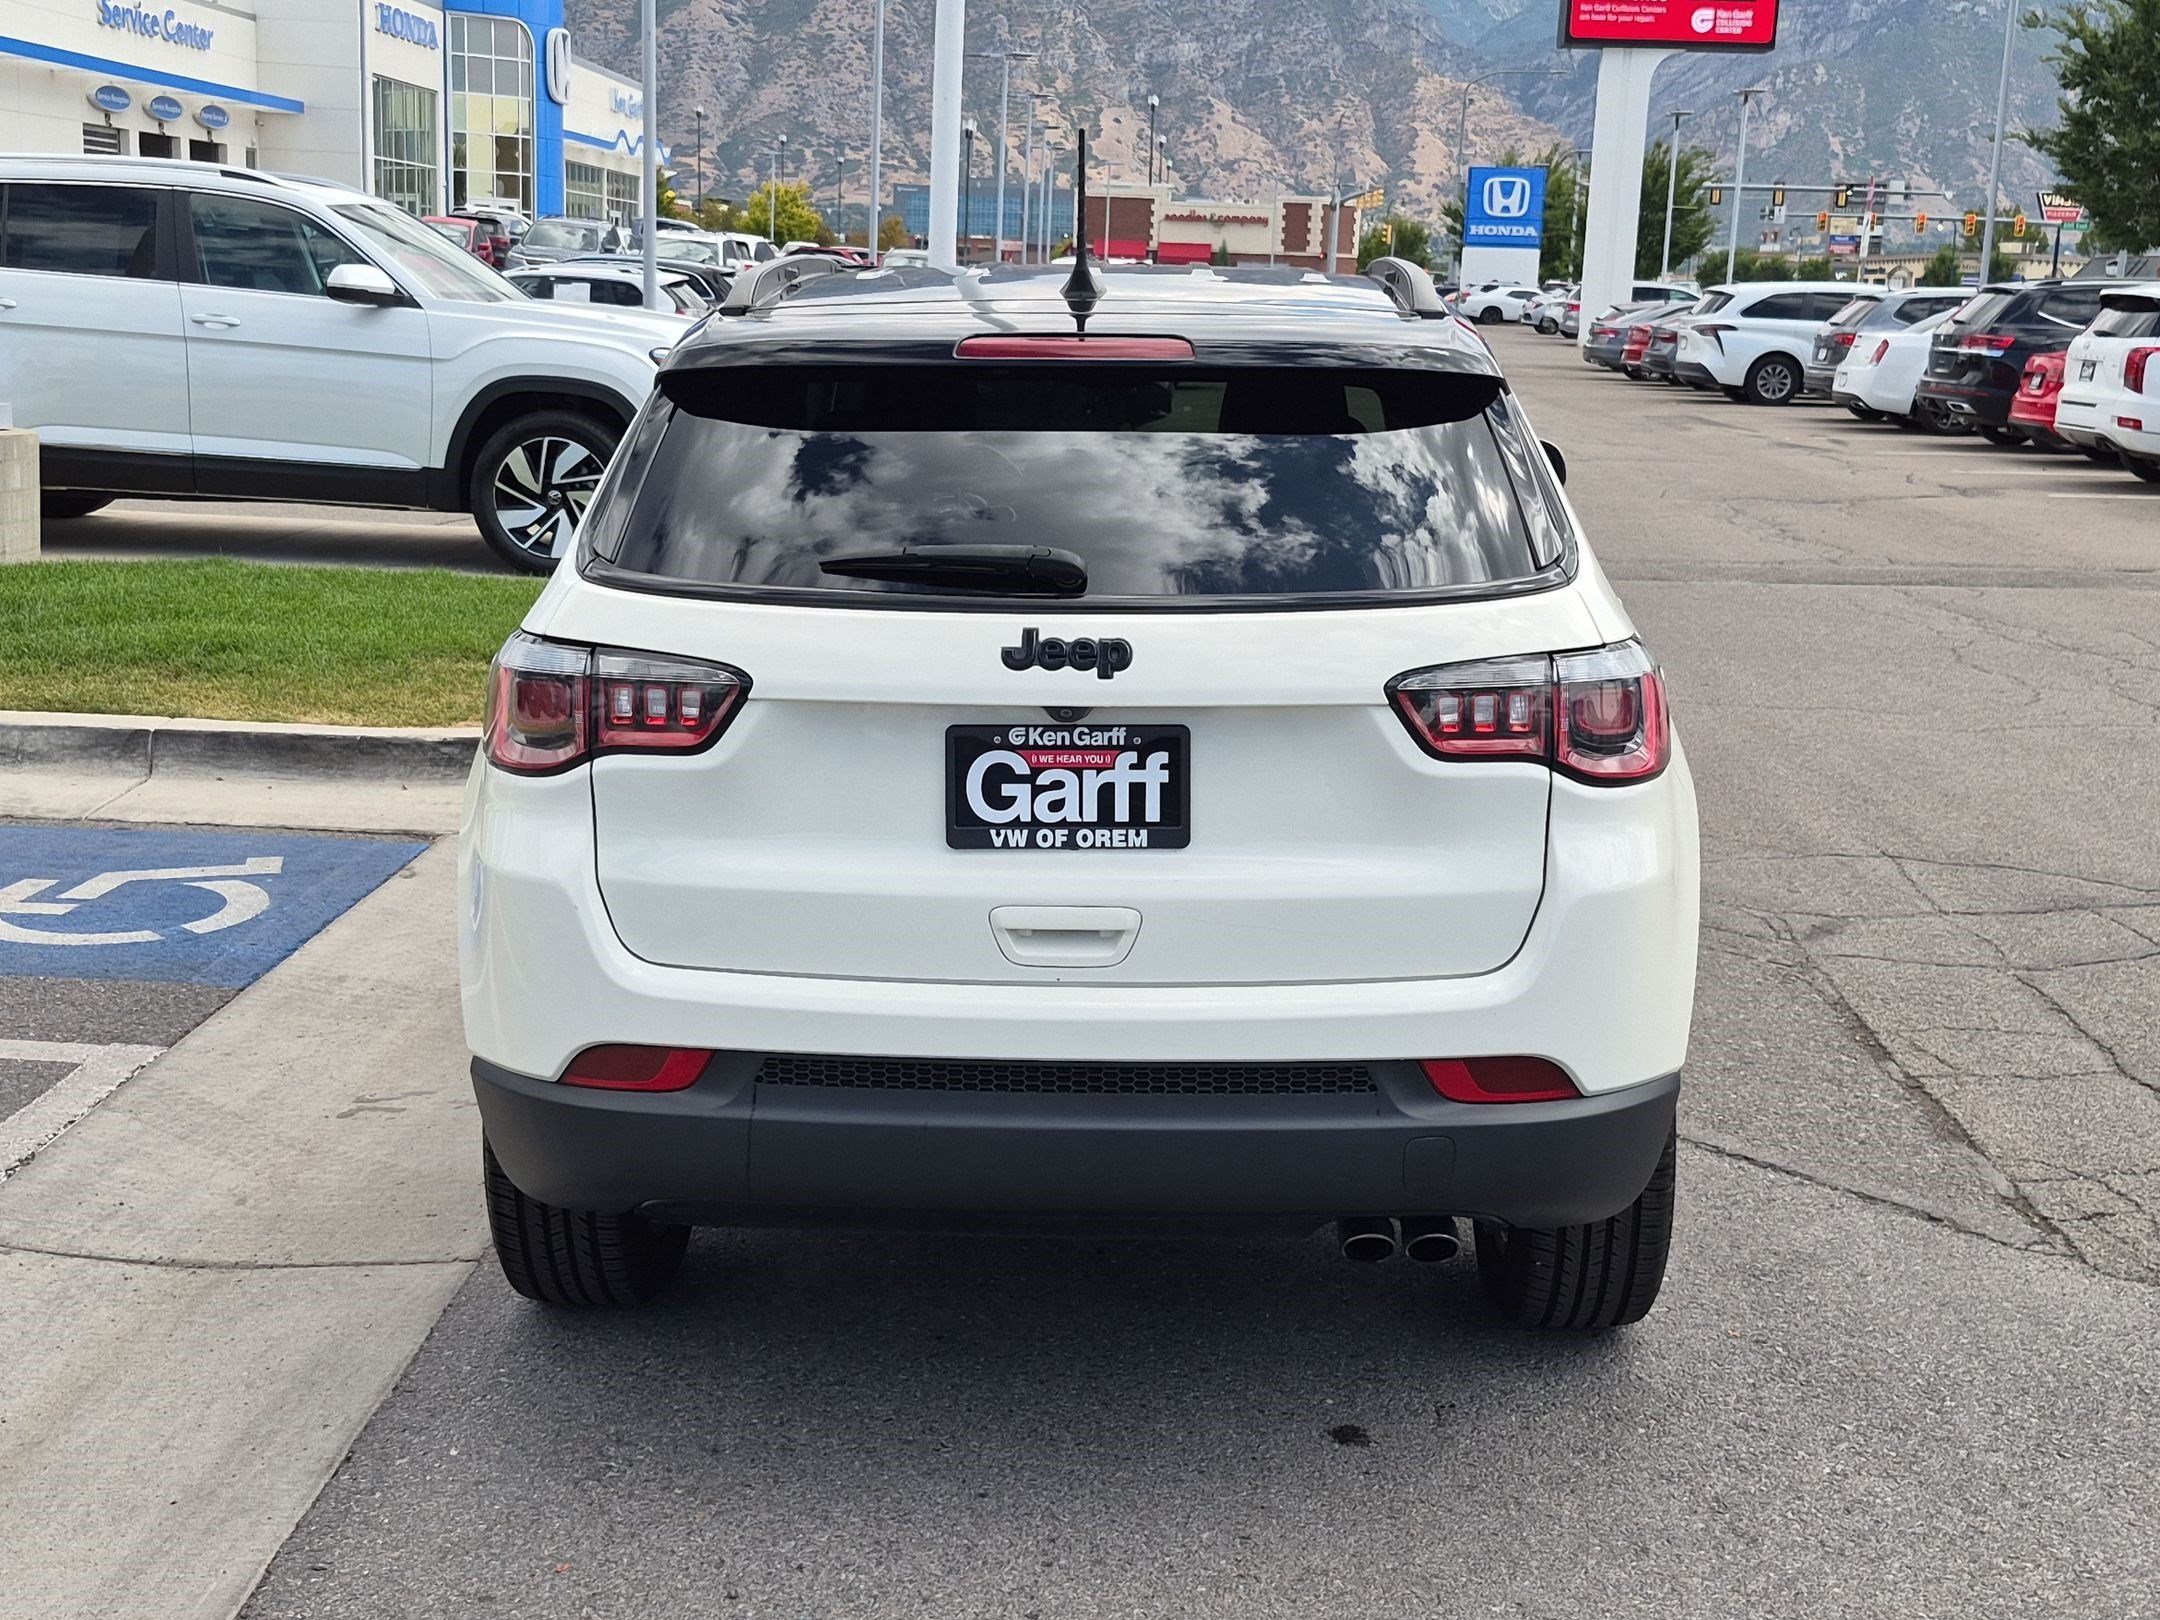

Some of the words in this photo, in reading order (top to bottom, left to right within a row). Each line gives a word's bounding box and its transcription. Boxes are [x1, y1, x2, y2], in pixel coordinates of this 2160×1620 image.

[98, 0, 160, 37] Service
[161, 9, 214, 51] Center
[375, 3, 439, 50] HONDA
[1217, 214, 1269, 228] company
[1469, 225, 1538, 237] HONDA
[1001, 627, 1133, 680] Jeep
[1029, 728, 1070, 746] Ken
[1073, 727, 1127, 746] Garff
[1039, 755, 1054, 764] WE
[1056, 755, 1083, 764] HEAR
[1085, 755, 1104, 764] YOU
[966, 750, 1169, 824] Garff
[990, 829, 1028, 848] VW
[1036, 829, 1068, 848] OF
[1076, 829, 1148, 848] OREM
